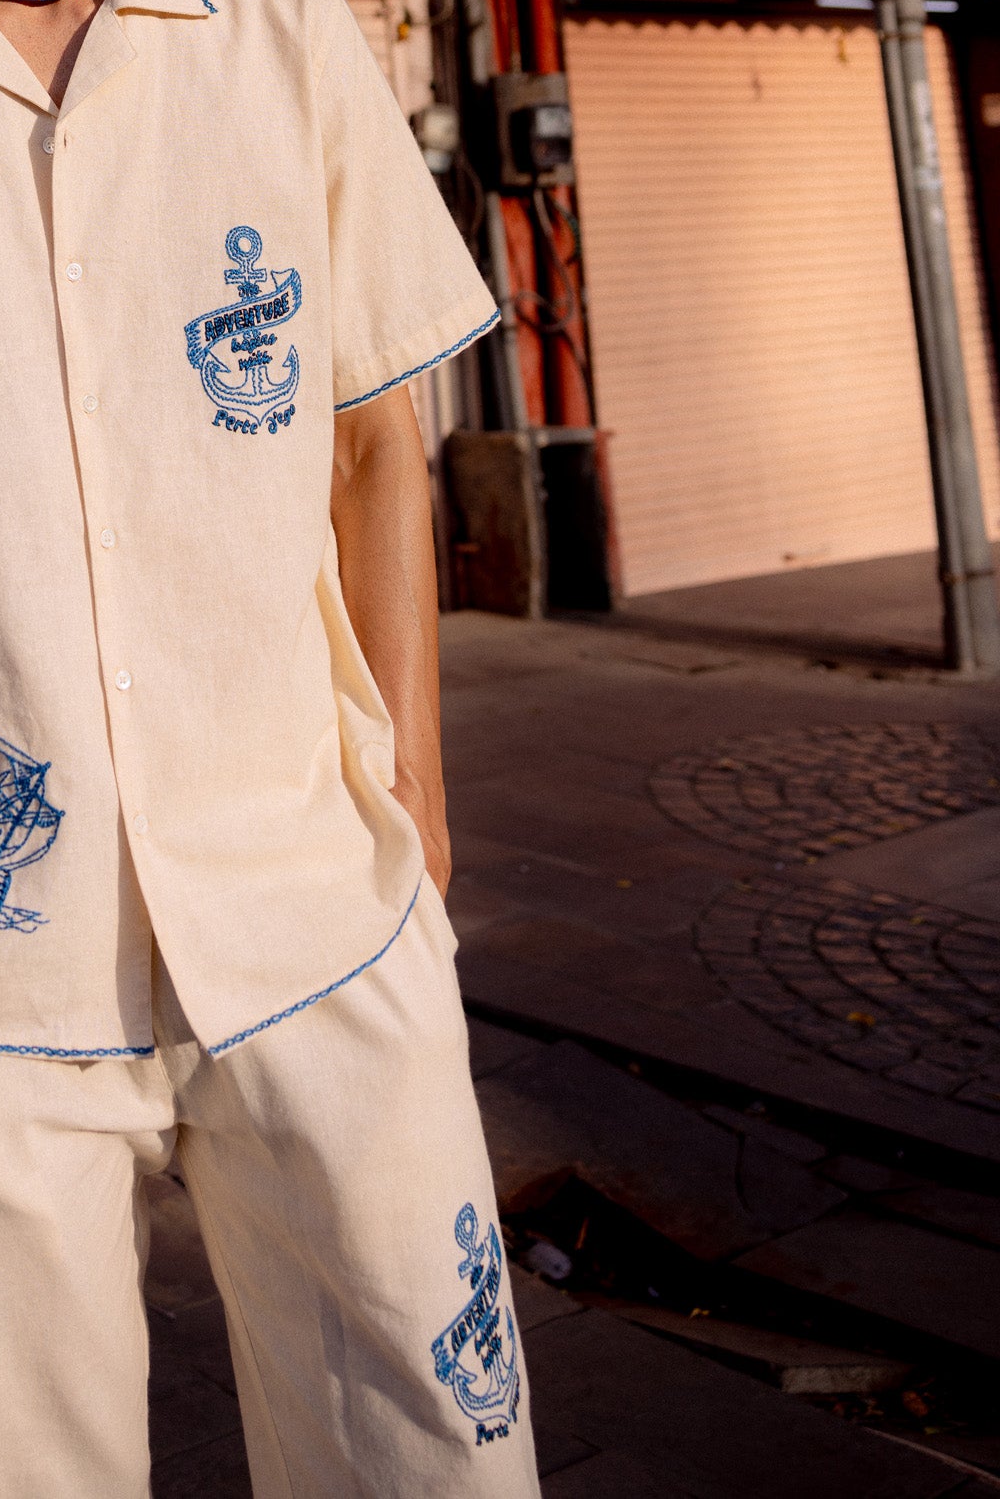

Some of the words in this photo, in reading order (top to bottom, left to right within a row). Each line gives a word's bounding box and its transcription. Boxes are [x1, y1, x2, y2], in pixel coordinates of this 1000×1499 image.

[204, 292, 291, 342] ADVENTURE
[211, 409, 259, 436] Perte
[265, 403, 296, 435] d'ego
